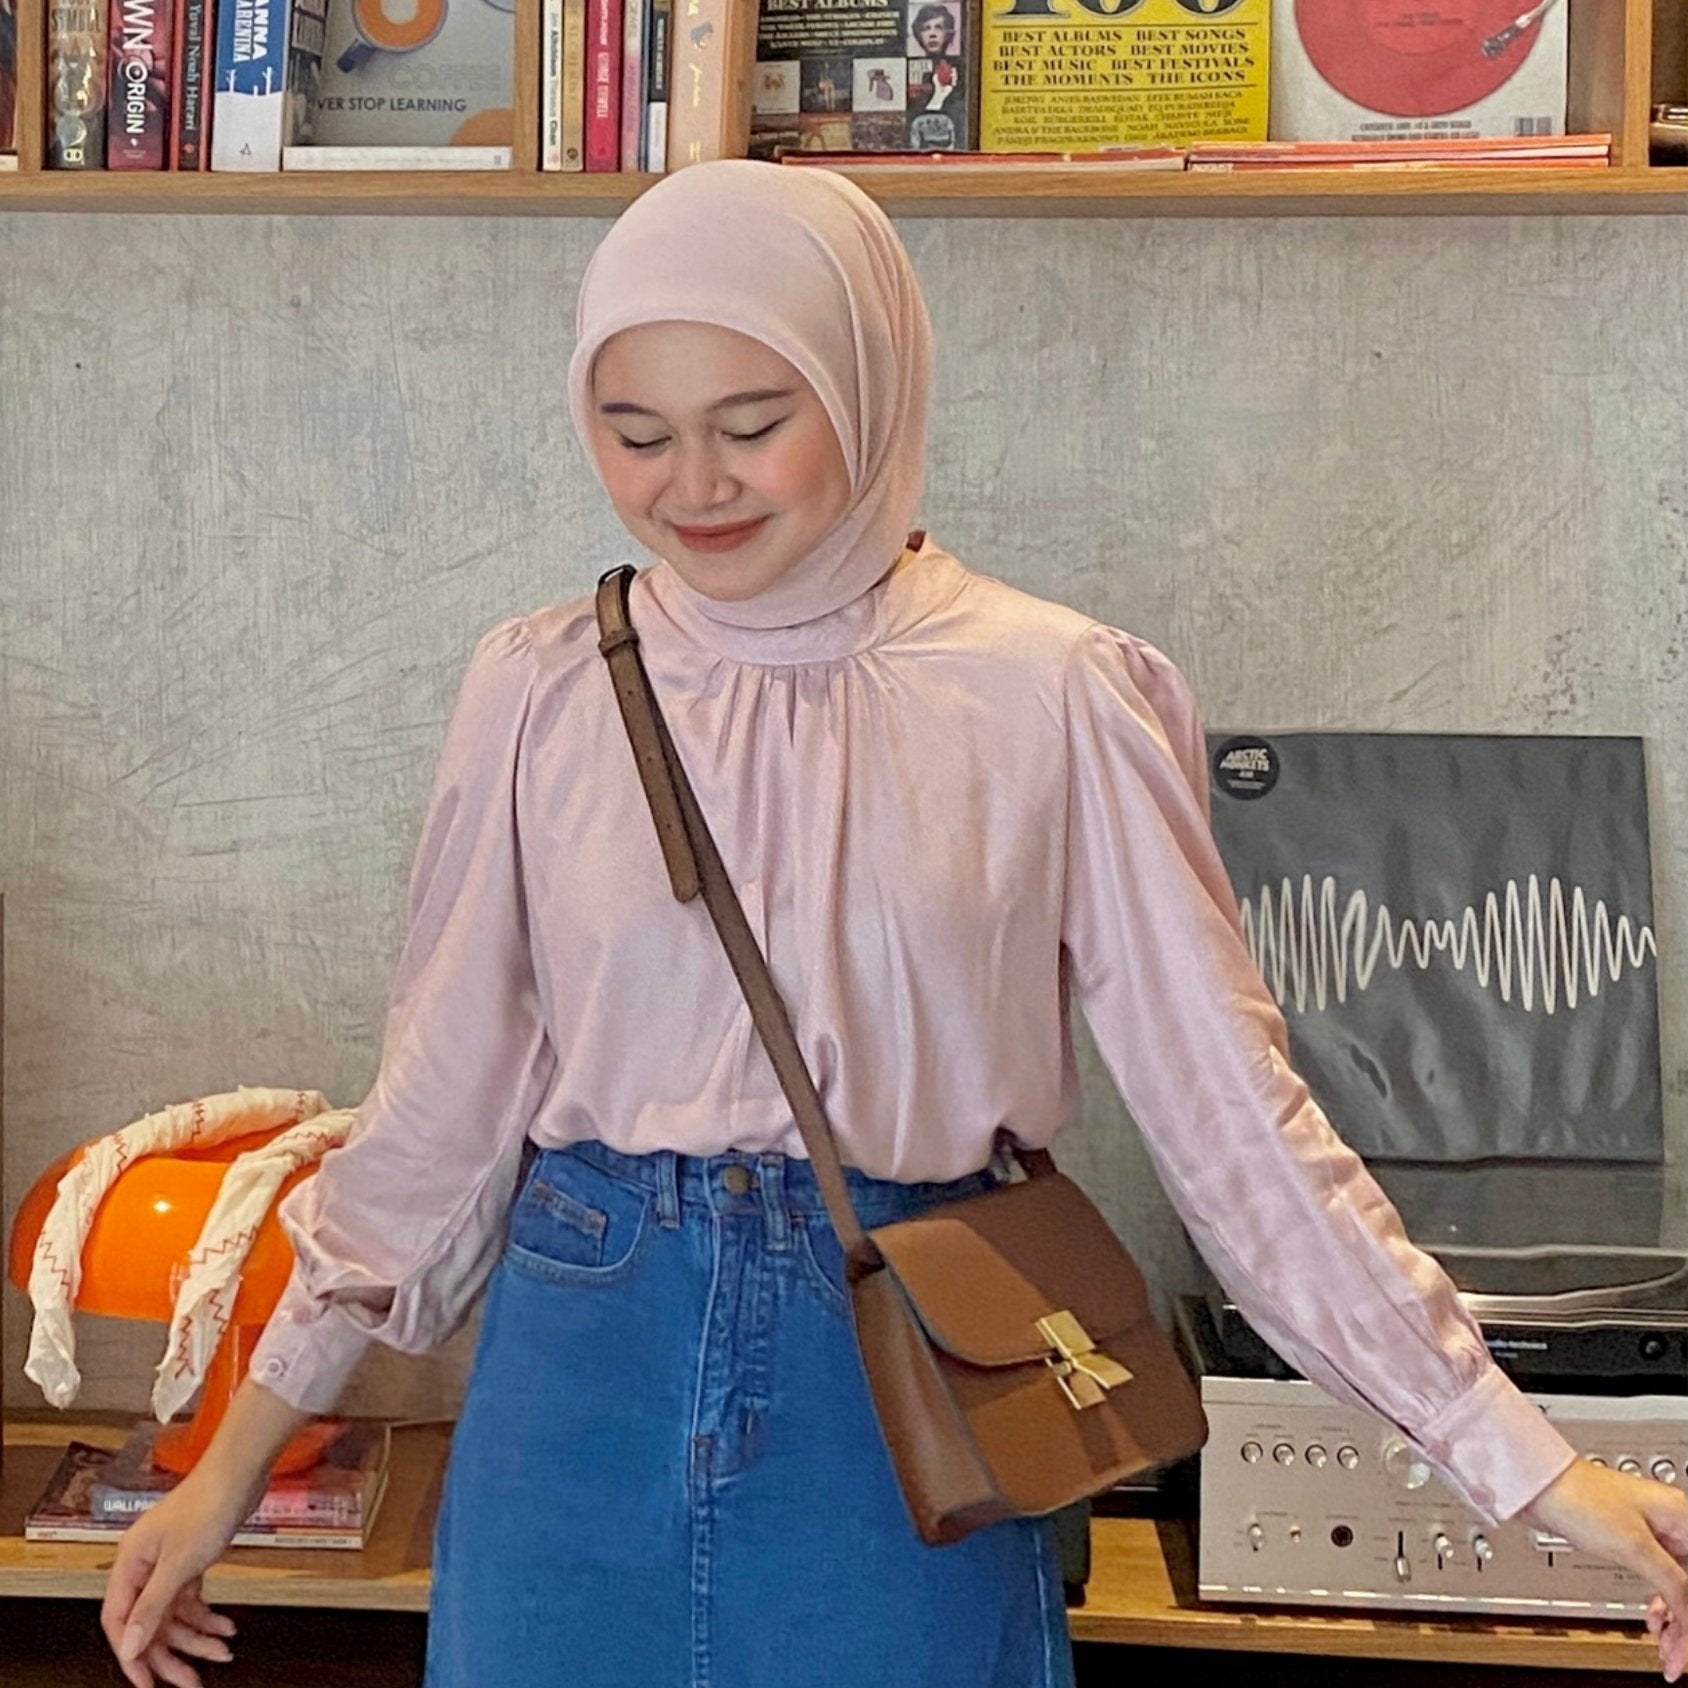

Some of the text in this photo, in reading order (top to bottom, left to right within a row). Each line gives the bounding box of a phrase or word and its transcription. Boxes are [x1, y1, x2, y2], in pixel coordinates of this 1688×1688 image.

[814, 0, 889, 9] ALBUMS
[252, 0, 268, 60] ANNA
[1003, 28, 1246, 42] BEST ALBUMS BEST SONGS
[999, 43, 1249, 57] BEST ACTORS BEST MOVIES
[185, 4, 201, 131] Yuval Noah Harari
[993, 57, 1255, 71] BEST MUSIC BEST FESTIVALS
[389, 63, 502, 91] COFFEE
[1001, 70, 1245, 86] THE MOMENTS THE ICONS
[125, 61, 149, 134] ORIGIN
[349, 97, 385, 111] STOP
[390, 98, 467, 112] LEARNING
[1225, 748, 1268, 761] ARCTIC
